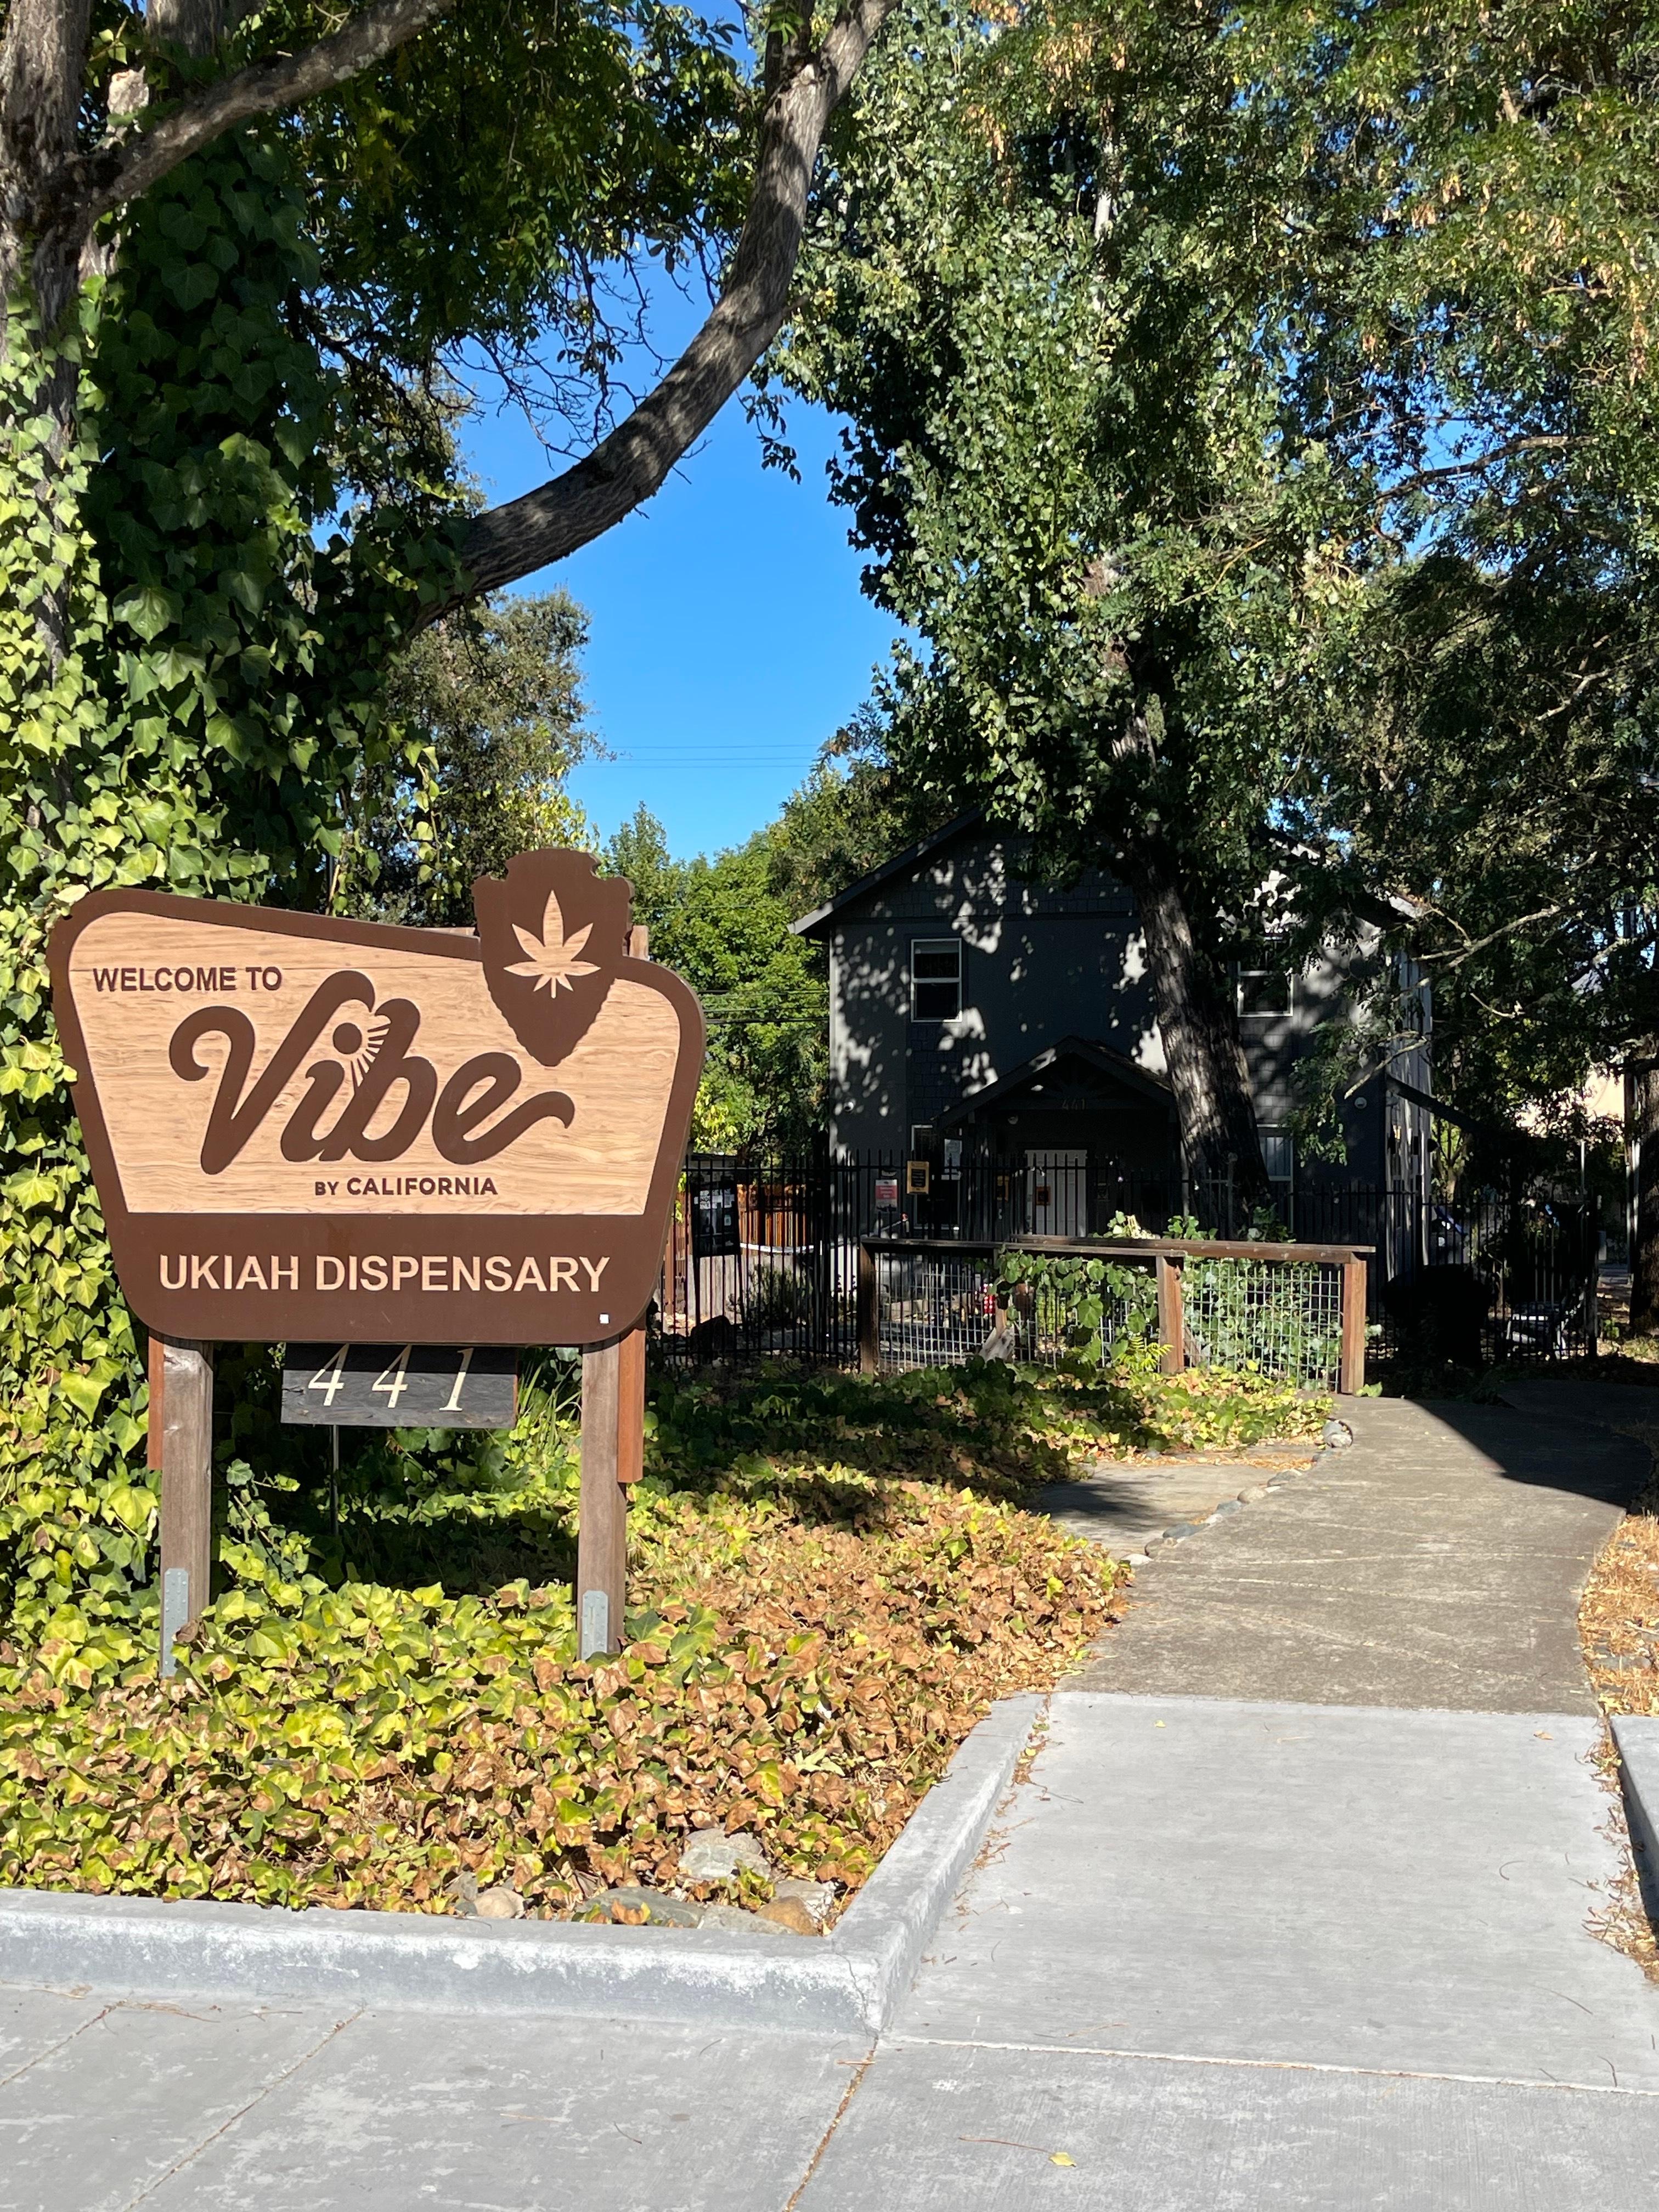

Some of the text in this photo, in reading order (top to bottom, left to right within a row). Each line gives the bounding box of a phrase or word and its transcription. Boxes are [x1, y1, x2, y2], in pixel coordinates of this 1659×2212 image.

[93, 967, 282, 991] WELCOME TO
[169, 970, 575, 1175] Vibe
[315, 1177, 498, 1195] BY CALIFORNIA
[160, 1254, 610, 1292] UKIAH DISPENSARY
